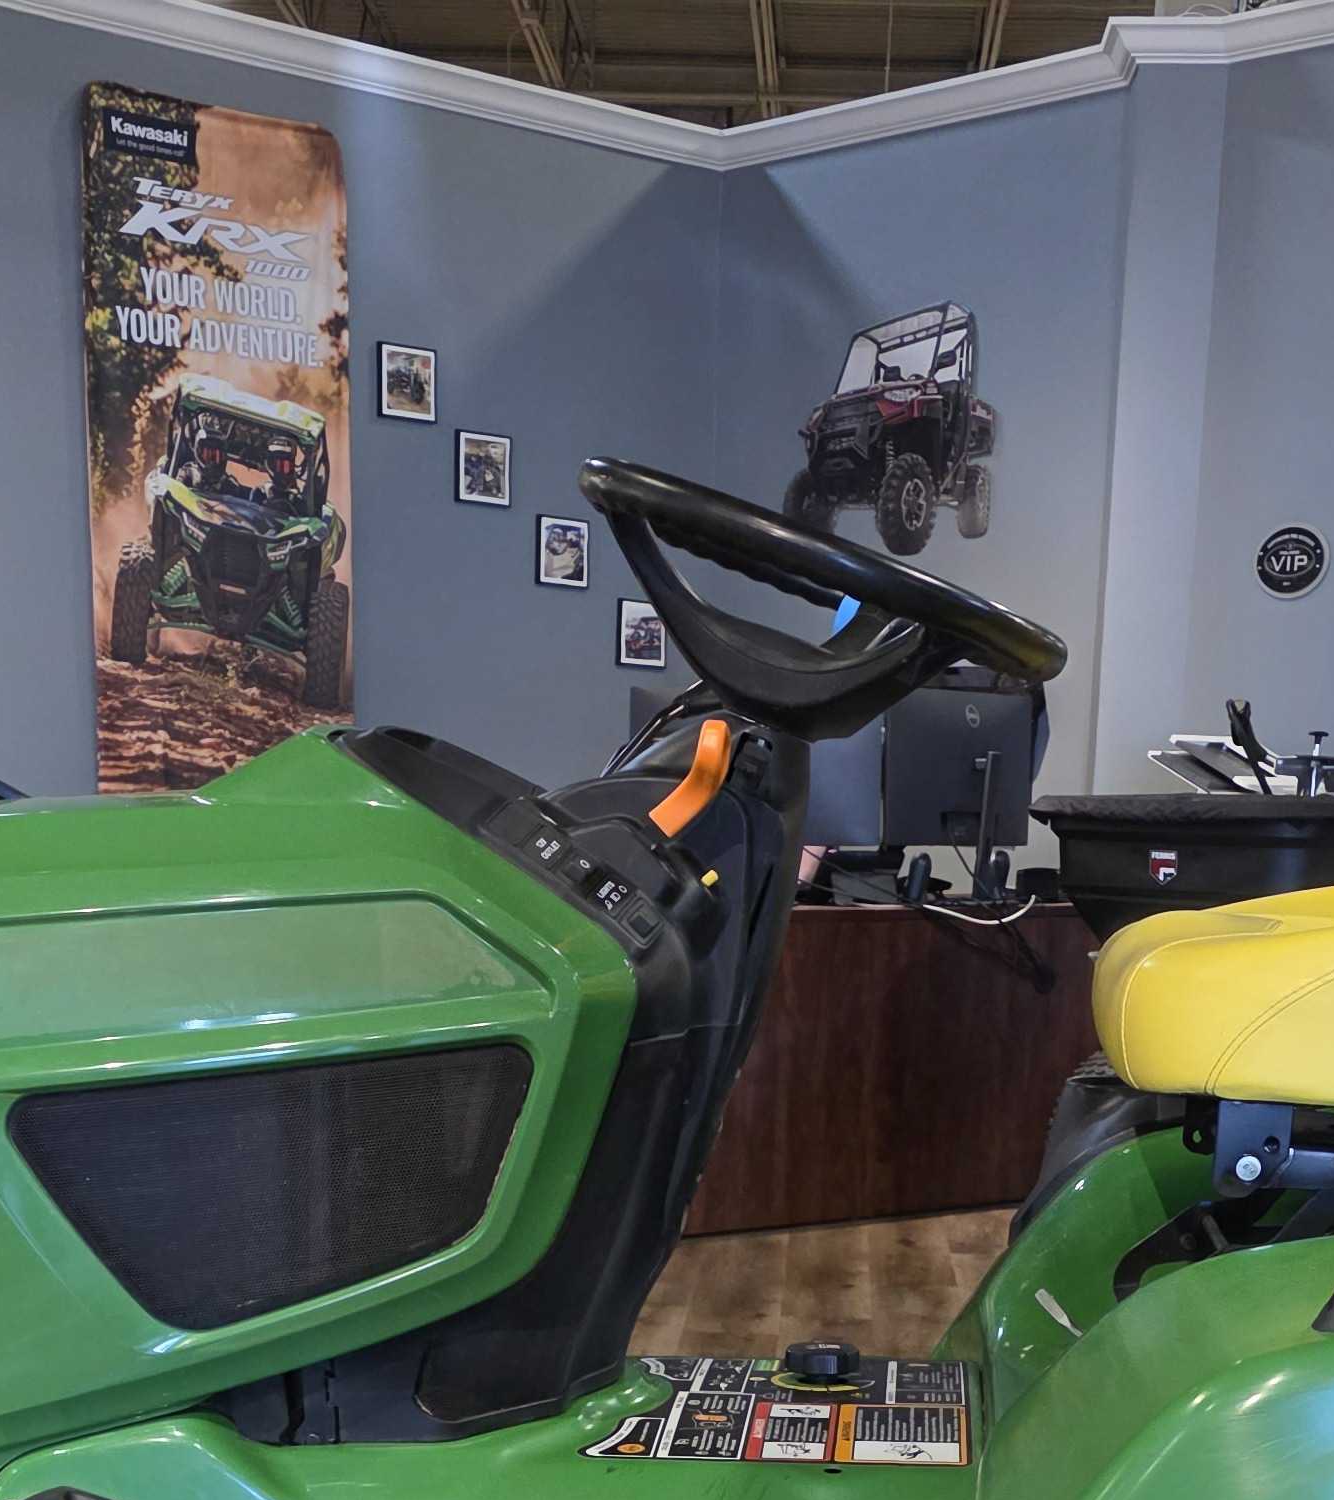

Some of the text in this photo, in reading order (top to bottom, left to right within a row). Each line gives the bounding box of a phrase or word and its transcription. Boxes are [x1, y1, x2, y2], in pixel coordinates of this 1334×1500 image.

[110, 116, 188, 147] Kawasaki
[118, 199, 312, 263] KRX
[246, 258, 311, 281] 1000
[140, 266, 302, 324] YOUR WORLD.
[116, 305, 324, 368] YOUR ADVENTURE.
[1270, 554, 1308, 572] VIP
